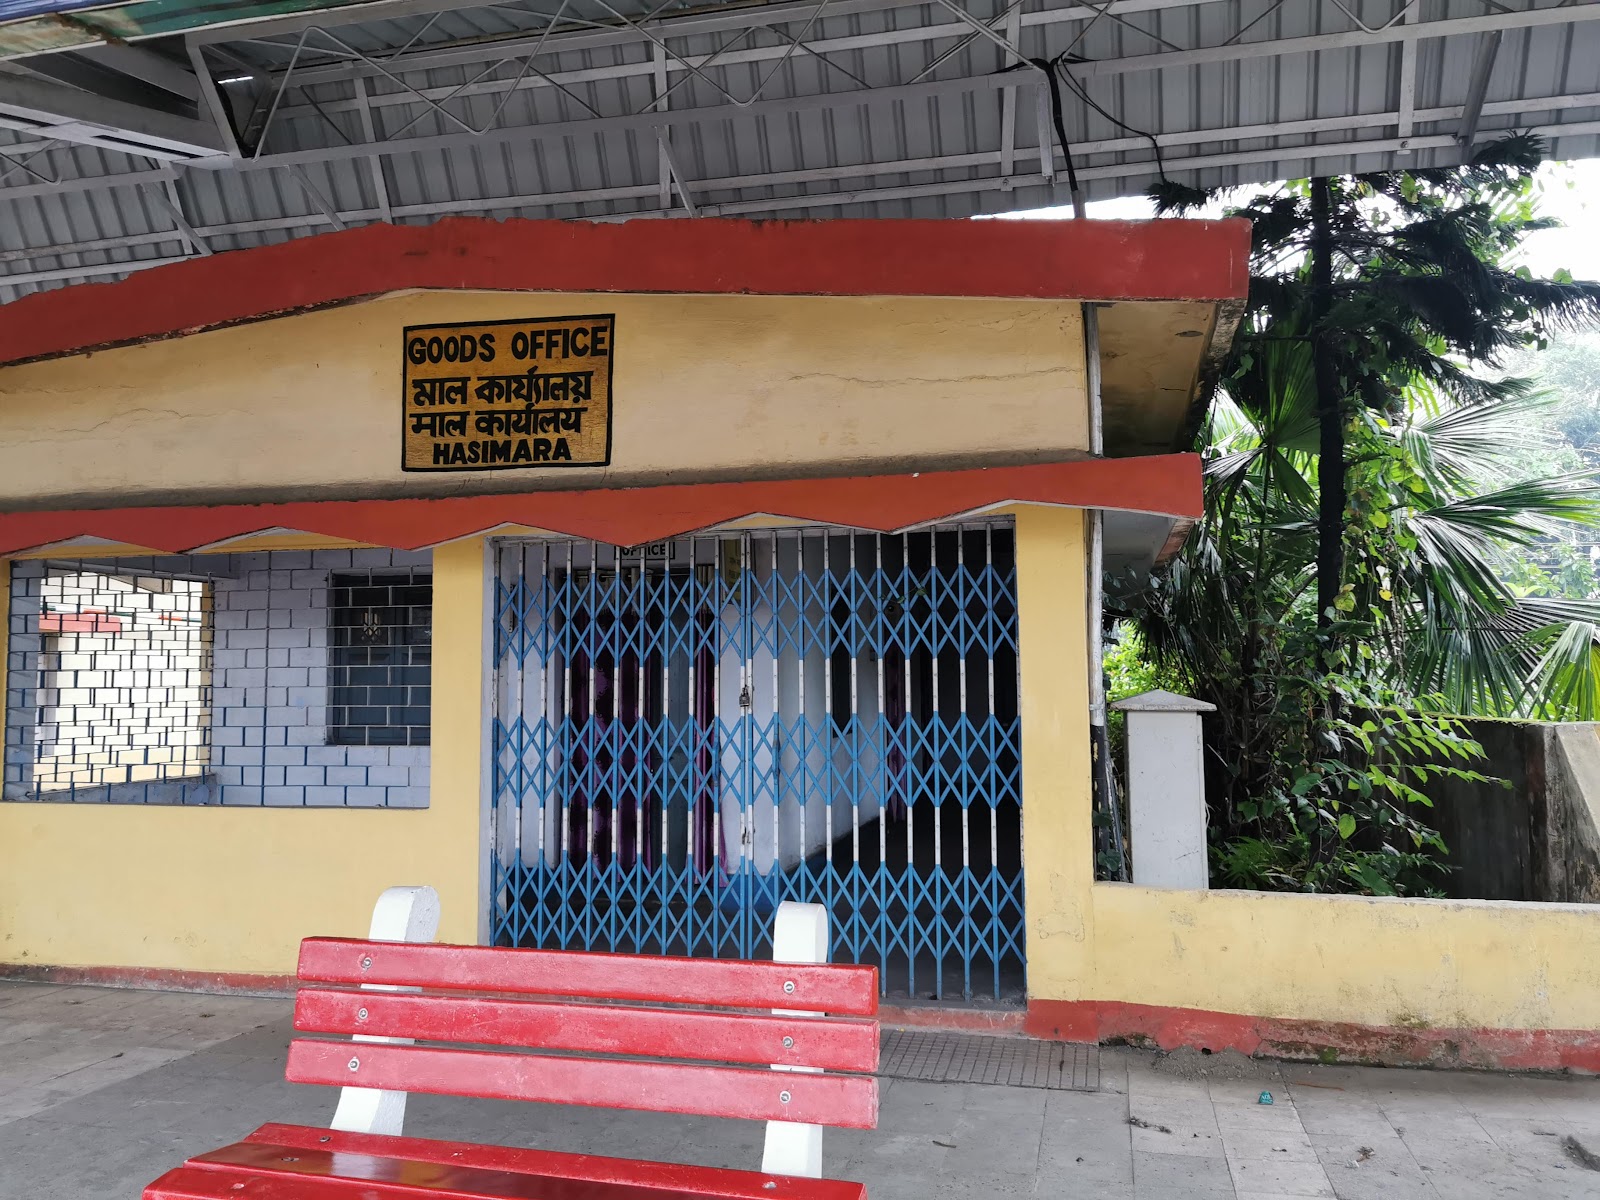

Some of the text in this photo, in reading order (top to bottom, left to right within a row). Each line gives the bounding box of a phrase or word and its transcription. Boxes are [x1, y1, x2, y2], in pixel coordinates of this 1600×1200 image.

[408, 326, 608, 365] GOODS OFFICE
[412, 376, 471, 406] মাল
[409, 402, 588, 438] माल कार्यालय
[432, 437, 572, 465] HASIMARA
